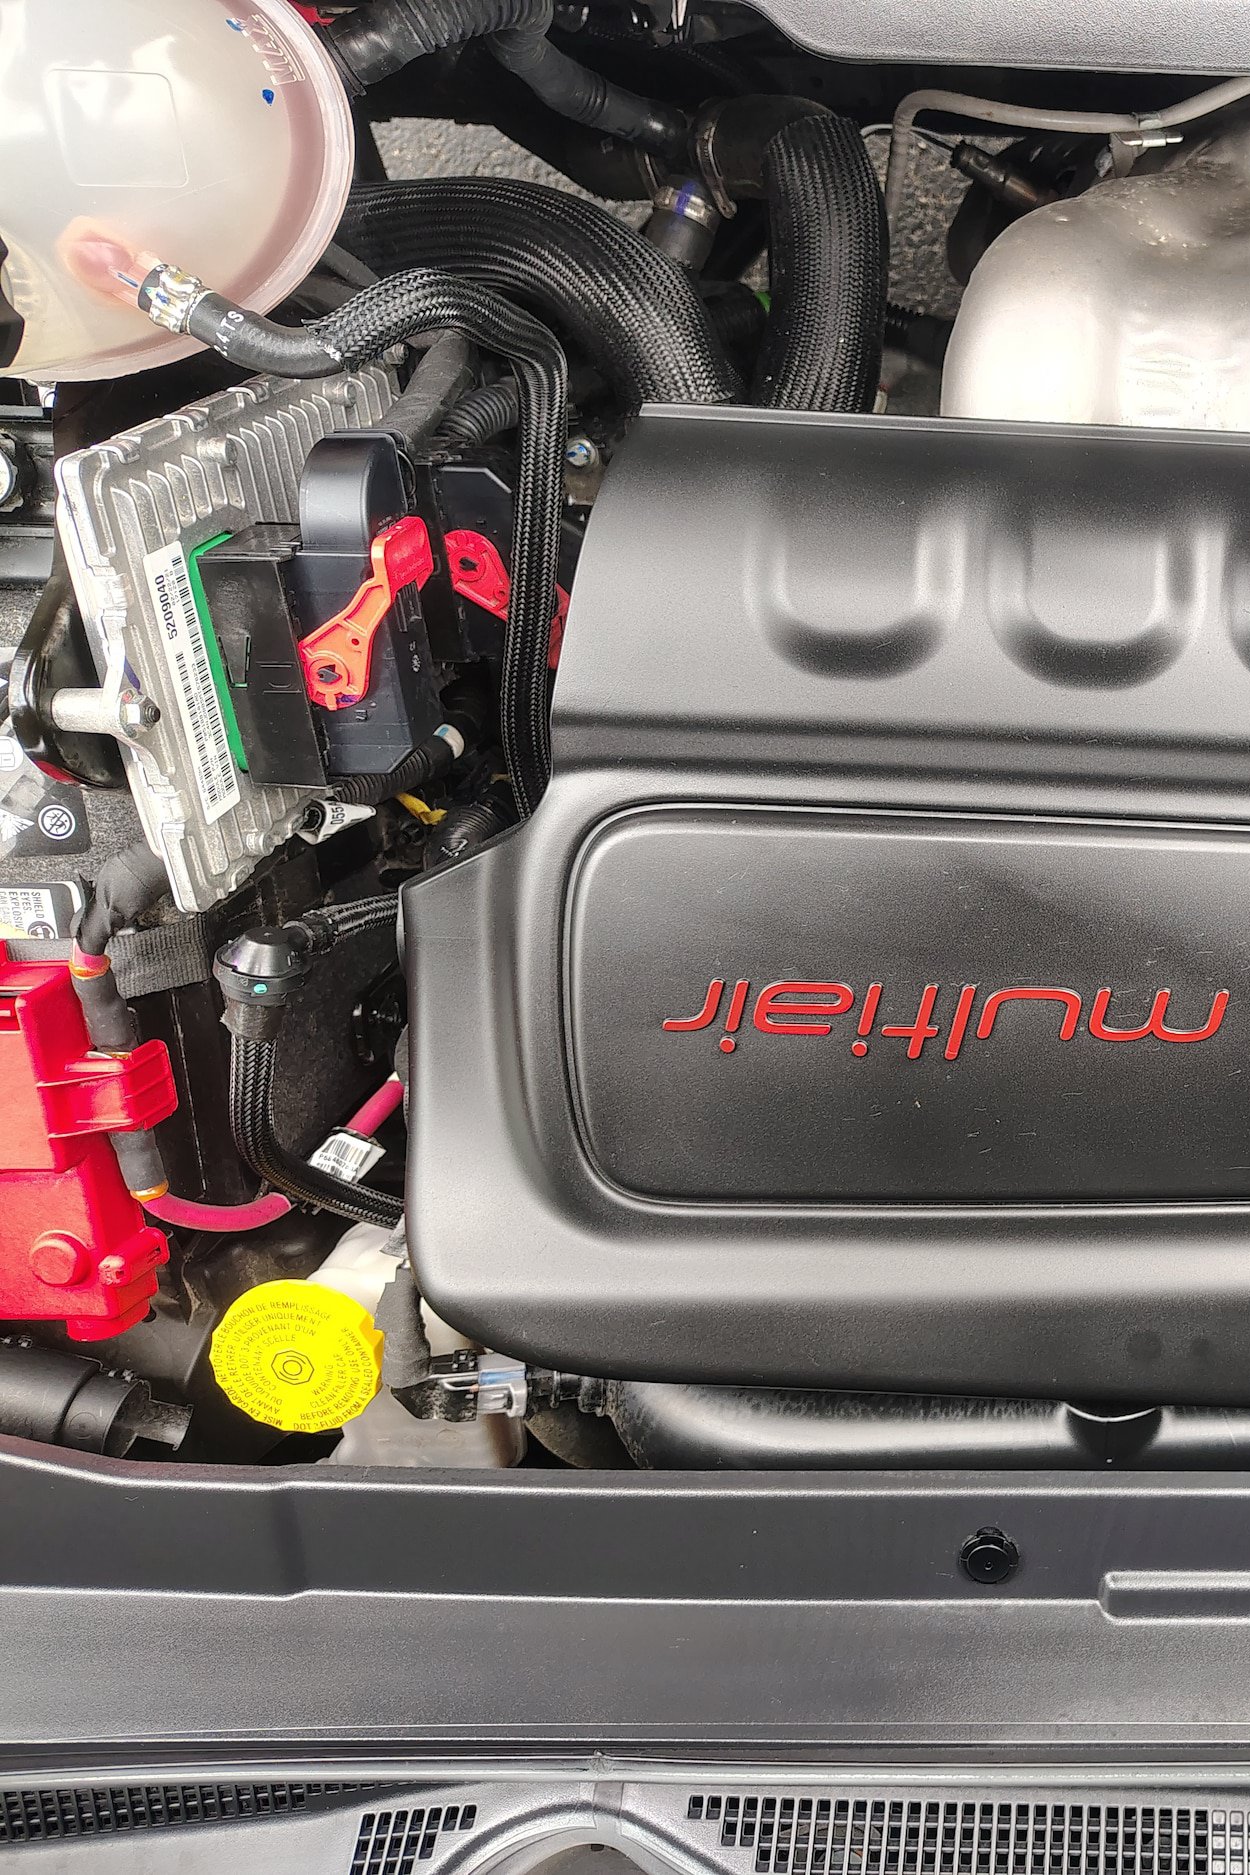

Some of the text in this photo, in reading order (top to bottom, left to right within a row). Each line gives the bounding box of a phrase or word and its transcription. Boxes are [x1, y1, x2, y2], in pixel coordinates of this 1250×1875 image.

[220, 310, 245, 330] TS
[154, 574, 178, 640] 5209040
[31, 891, 45, 919] SHIELD
[662, 978, 1230, 1060] multiair
[256, 1303, 267, 1312] DE
[270, 1301, 332, 1321] REMPLISSAGE
[223, 1307, 255, 1334] BOUCHON
[263, 1312, 322, 1326] UNIQUEMENT
[246, 1323, 291, 1348] PROVENANT
[226, 1384, 249, 1409] GARDE
[253, 1394, 280, 1415] AVANT
[300, 1408, 335, 1421] BEFORE
[333, 1377, 360, 1410] REMOVING
[249, 1407, 260, 1418] EN
[263, 1412, 283, 1427] MISE
[293, 1422, 312, 1431] DOT
